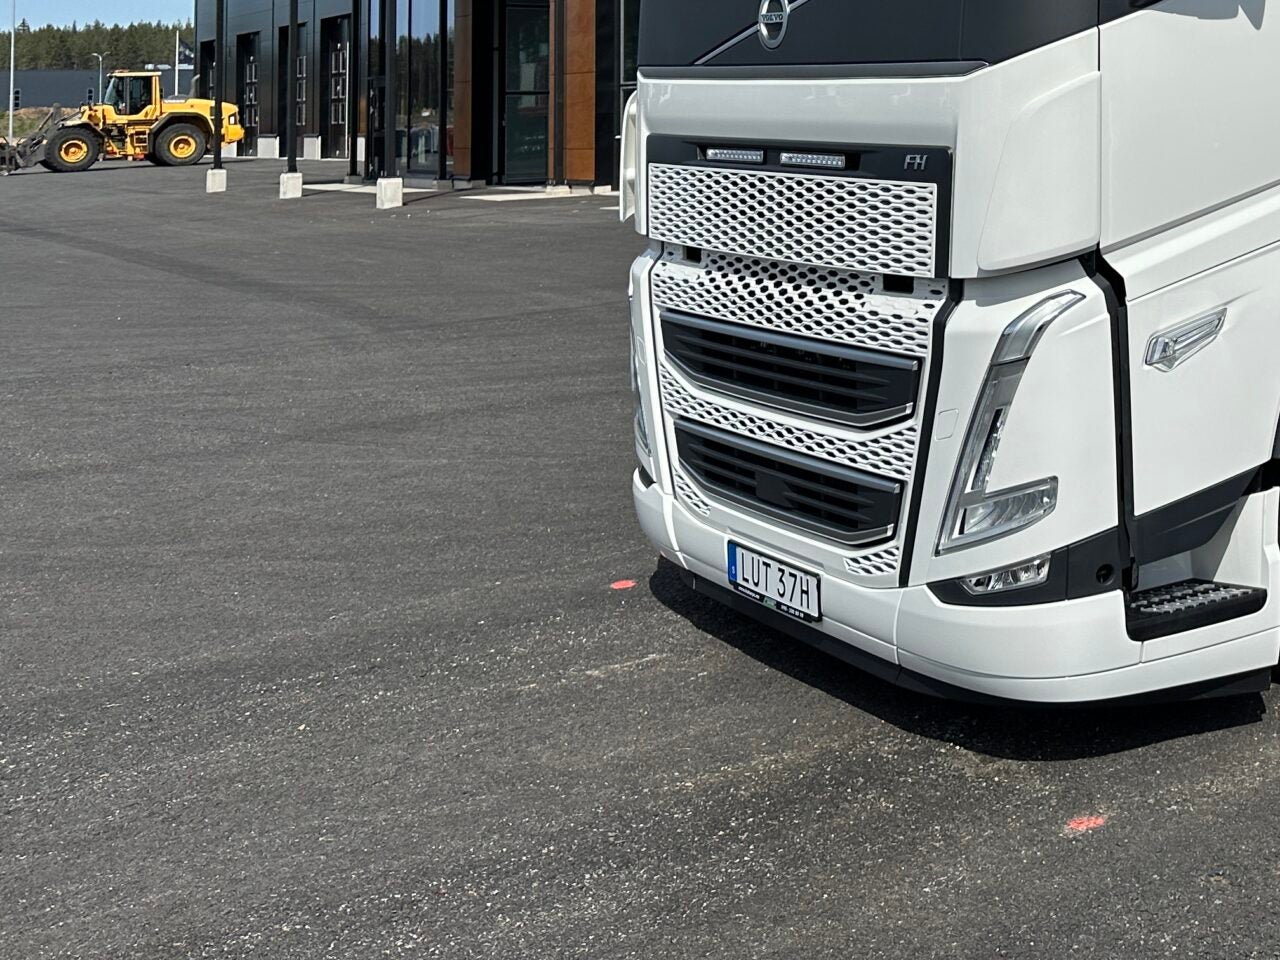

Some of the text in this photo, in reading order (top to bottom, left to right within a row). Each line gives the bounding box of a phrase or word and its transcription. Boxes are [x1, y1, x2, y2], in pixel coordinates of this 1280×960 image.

[904, 154, 928, 170] FH
[741, 551, 810, 610] LUT 37H
